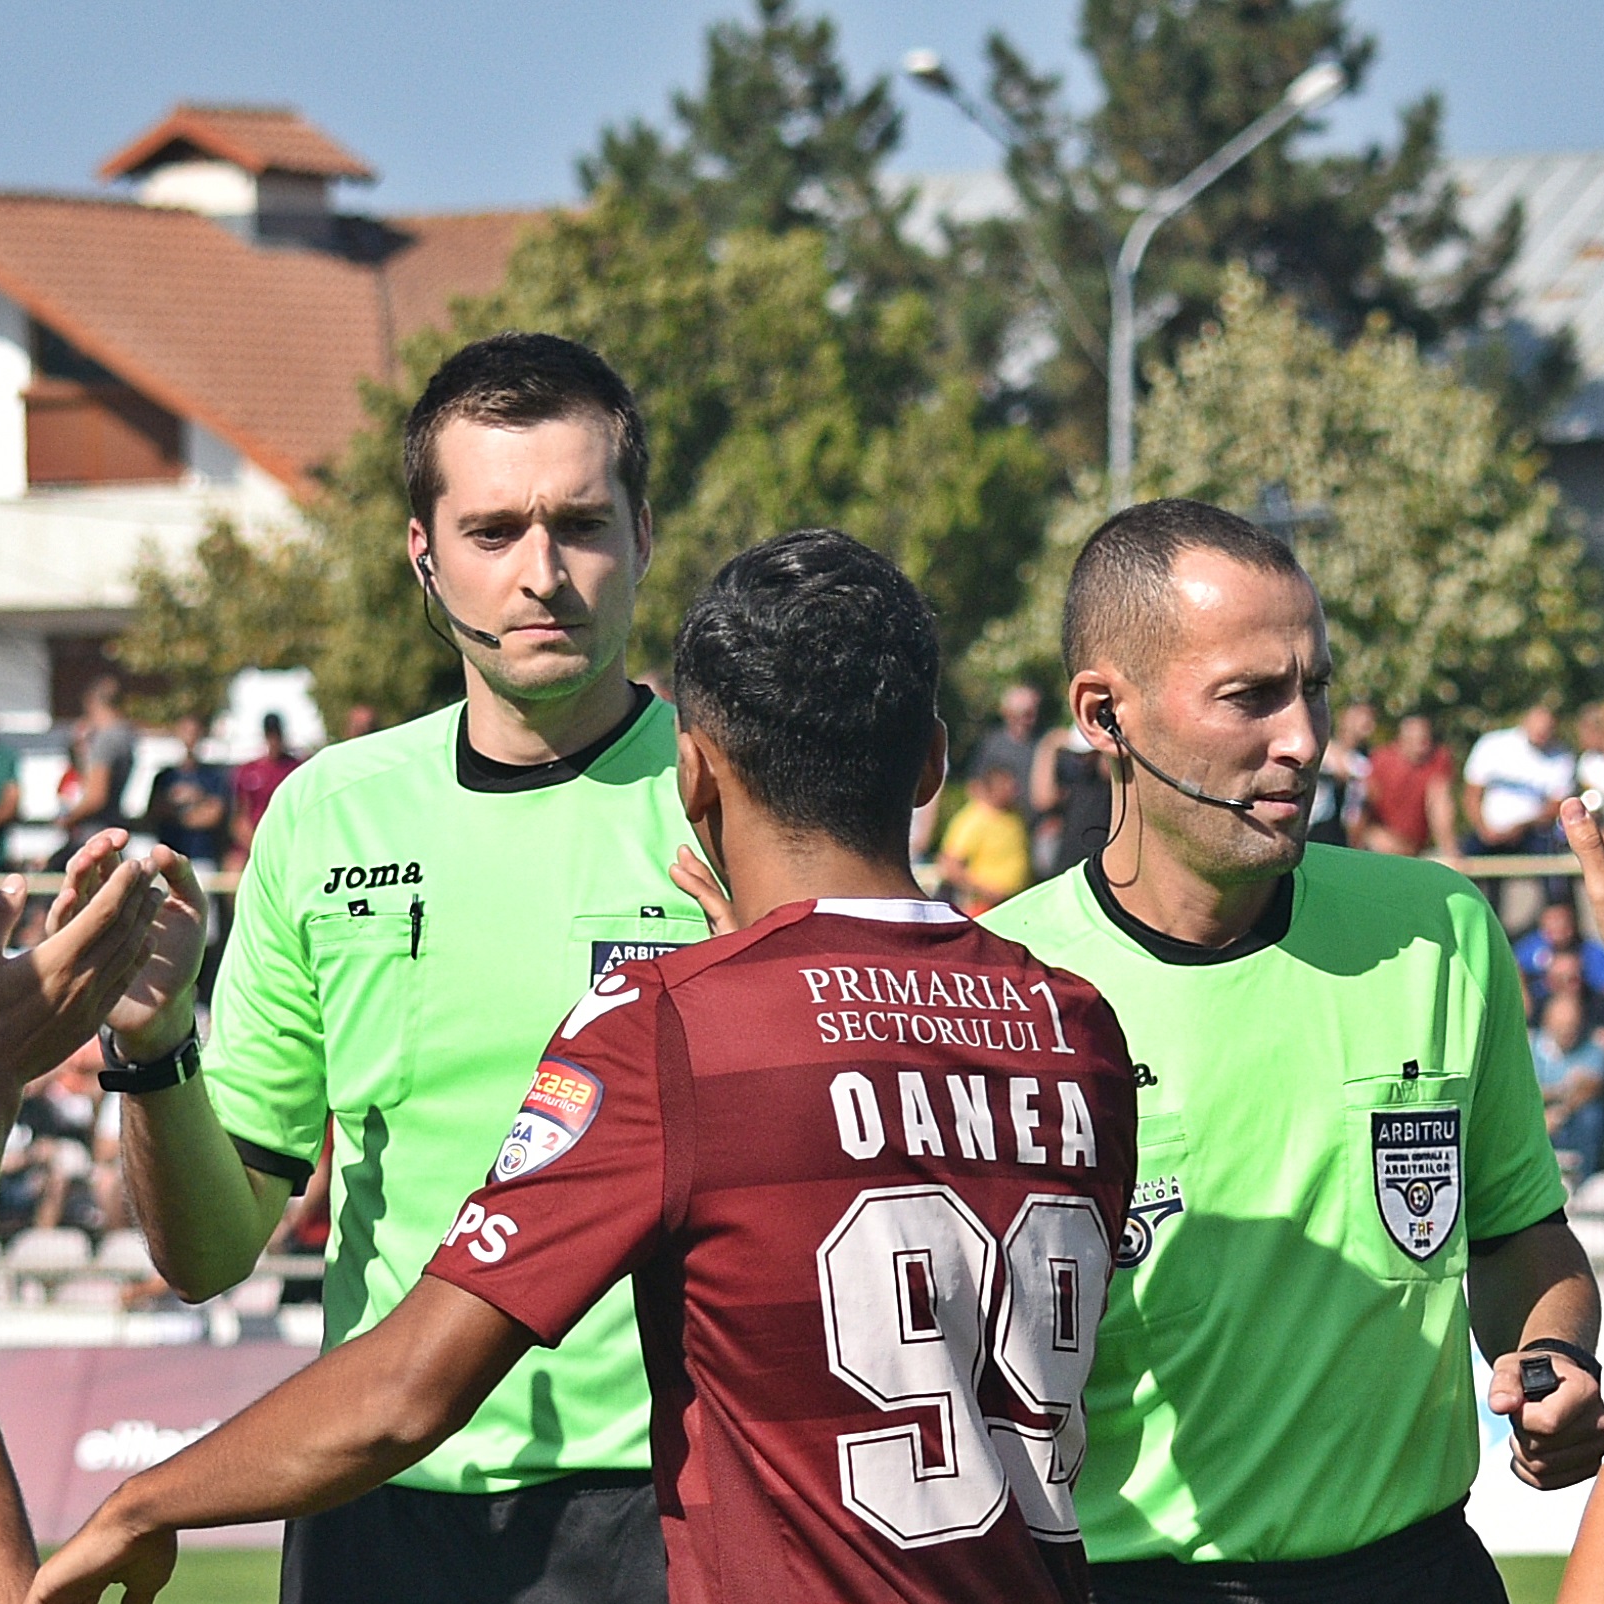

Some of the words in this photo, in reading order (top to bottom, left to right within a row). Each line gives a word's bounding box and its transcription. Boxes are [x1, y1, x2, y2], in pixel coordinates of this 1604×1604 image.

[324, 862, 423, 894] Joma
[798, 966, 1030, 1012] PRIMARIA
[816, 1010, 1042, 1052] SECTORULUI
[1030, 981, 1075, 1054] 1
[535, 1072, 592, 1105] casa
[829, 1071, 1098, 1168] OANEA
[1378, 1120, 1455, 1142] ARBITRU
[542, 1131, 559, 1151] 2
[1385, 1163, 1451, 1175] ARBITRILOR
[442, 1201, 519, 1264] PS
[1408, 1221, 1435, 1237] FRF
[815, 1183, 1112, 1550] 99
